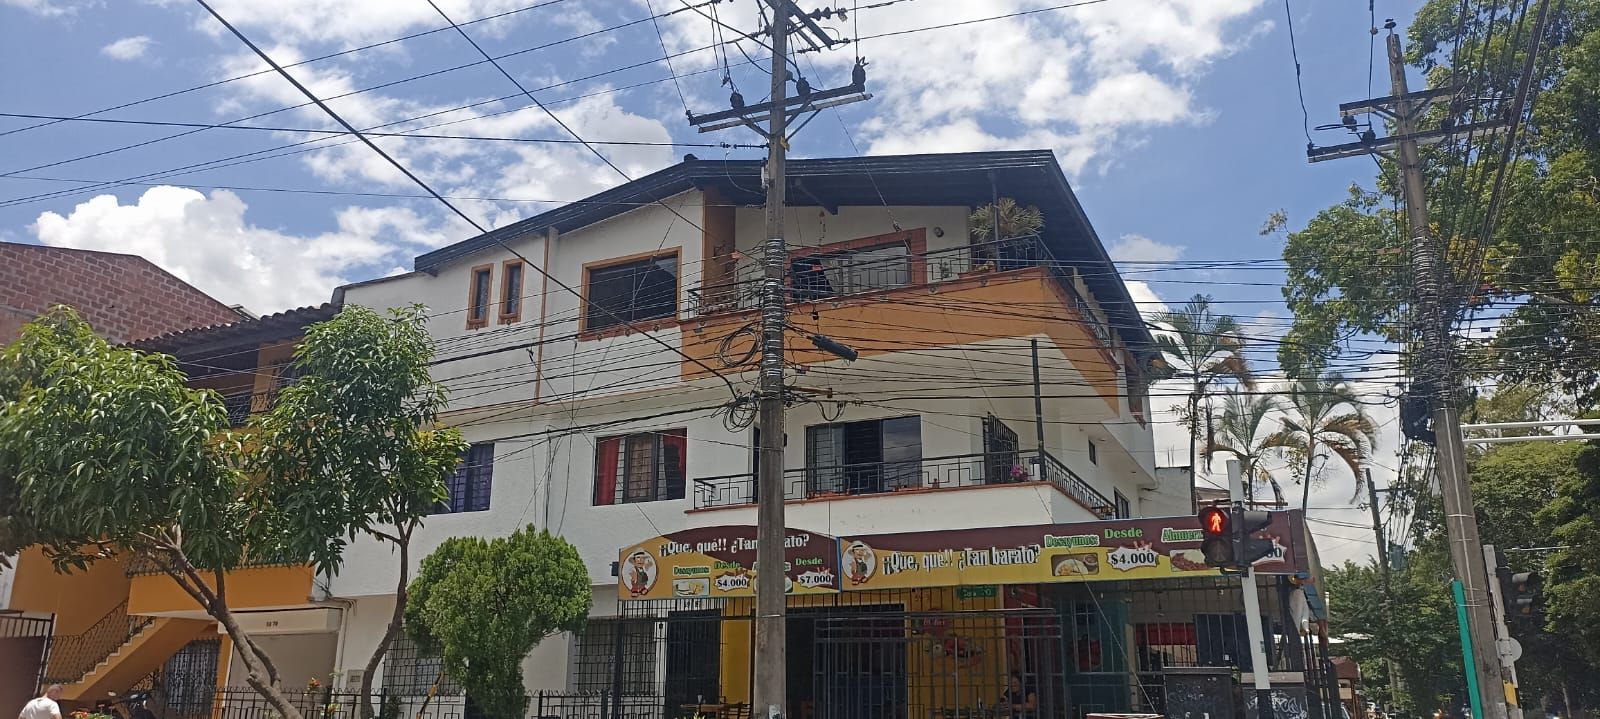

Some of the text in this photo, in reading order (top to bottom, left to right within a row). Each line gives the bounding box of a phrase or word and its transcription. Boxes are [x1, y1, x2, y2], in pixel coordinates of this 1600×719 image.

[1104, 527, 1143, 539] Desde
[696, 538, 727, 554] qué!!
[784, 534, 810, 548] ato?
[795, 557, 823, 566] Desde
[958, 547, 989, 571] ¿Tan
[991, 543, 1040, 565] barato?
[1110, 552, 1155, 565] $4.000
[714, 561, 741, 570] Desde
[717, 578, 747, 588] $4.000
[800, 575, 832, 585] $7.000
